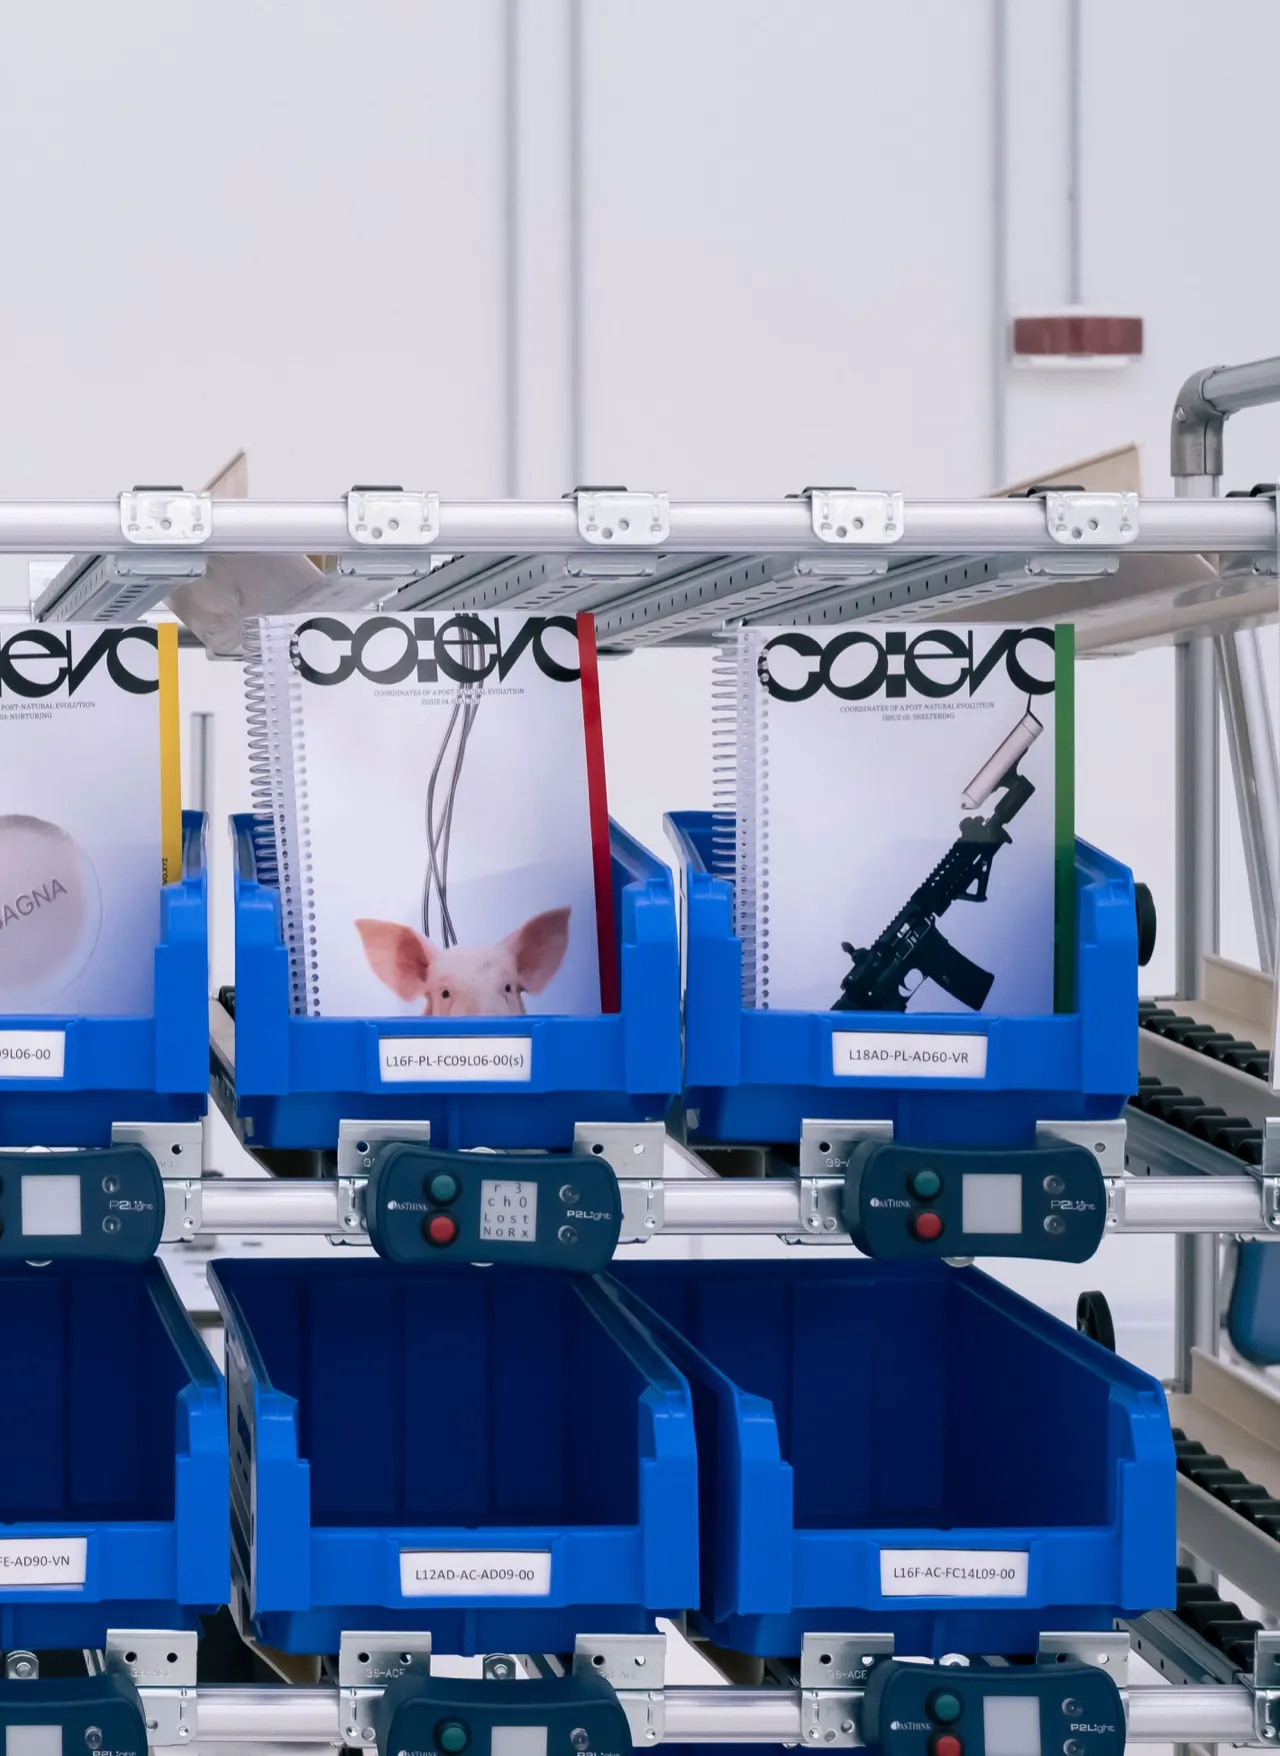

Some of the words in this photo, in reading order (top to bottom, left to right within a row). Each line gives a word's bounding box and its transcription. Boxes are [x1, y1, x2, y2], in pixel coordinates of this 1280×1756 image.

[373, 689, 421, 697] COORDINATES
[487, 687, 525, 695] EVOLUTION
[55, 701, 96, 710] EVOLUTION
[840, 705, 888, 713] COORDINATES
[889, 704, 899, 712] OF
[956, 701, 995, 710] EVOLUTION
[386, 1054, 524, 1068] L16F-PL-FC09L06-00(s)
[849, 1049, 969, 1063] L18AD-PL-AD60-VR
[415, 1569, 535, 1581] L12AD-AC-AD09-00
[894, 1567, 1016, 1579] L16F-AC-FC14L09-00
